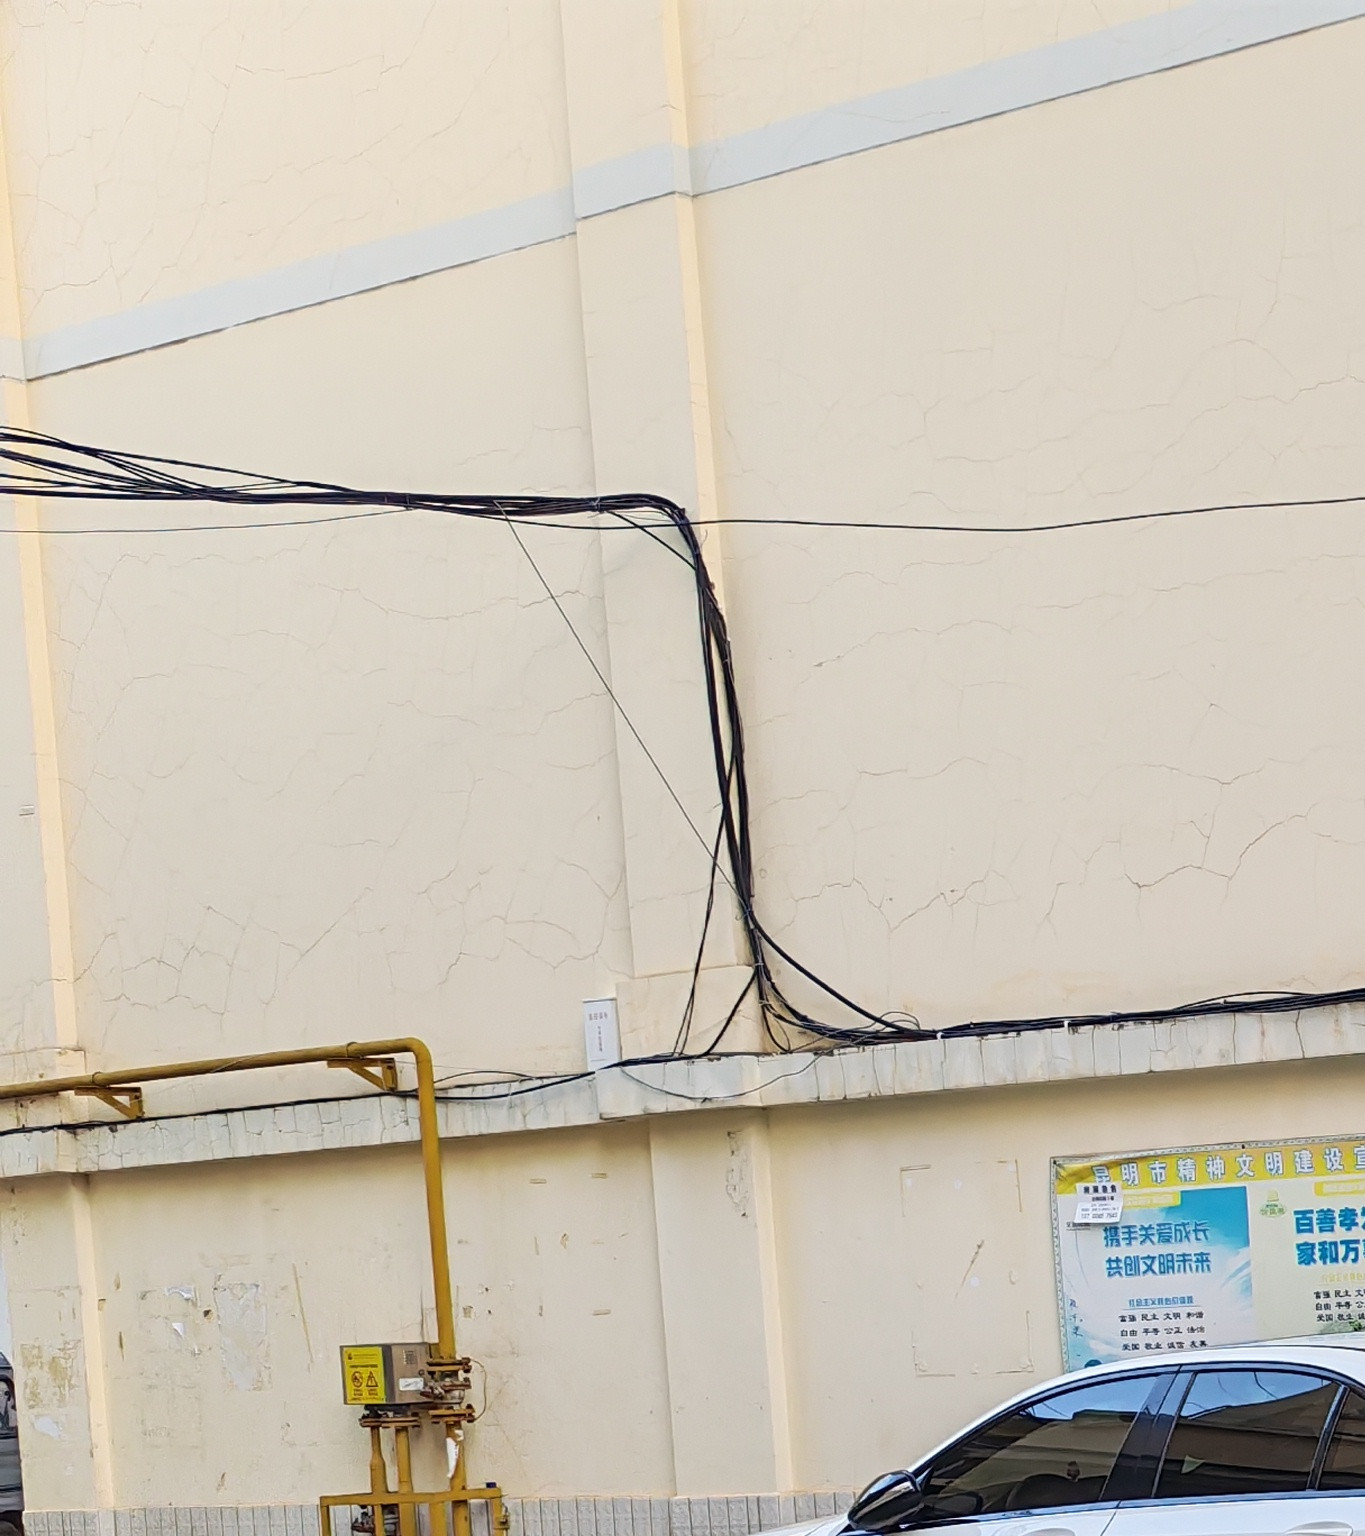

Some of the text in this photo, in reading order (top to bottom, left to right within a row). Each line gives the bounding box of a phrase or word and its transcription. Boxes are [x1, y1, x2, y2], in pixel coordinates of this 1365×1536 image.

[1103, 1220, 1210, 1247] 携手关爱成长
[1105, 1252, 1212, 1278] 共创文明未来
